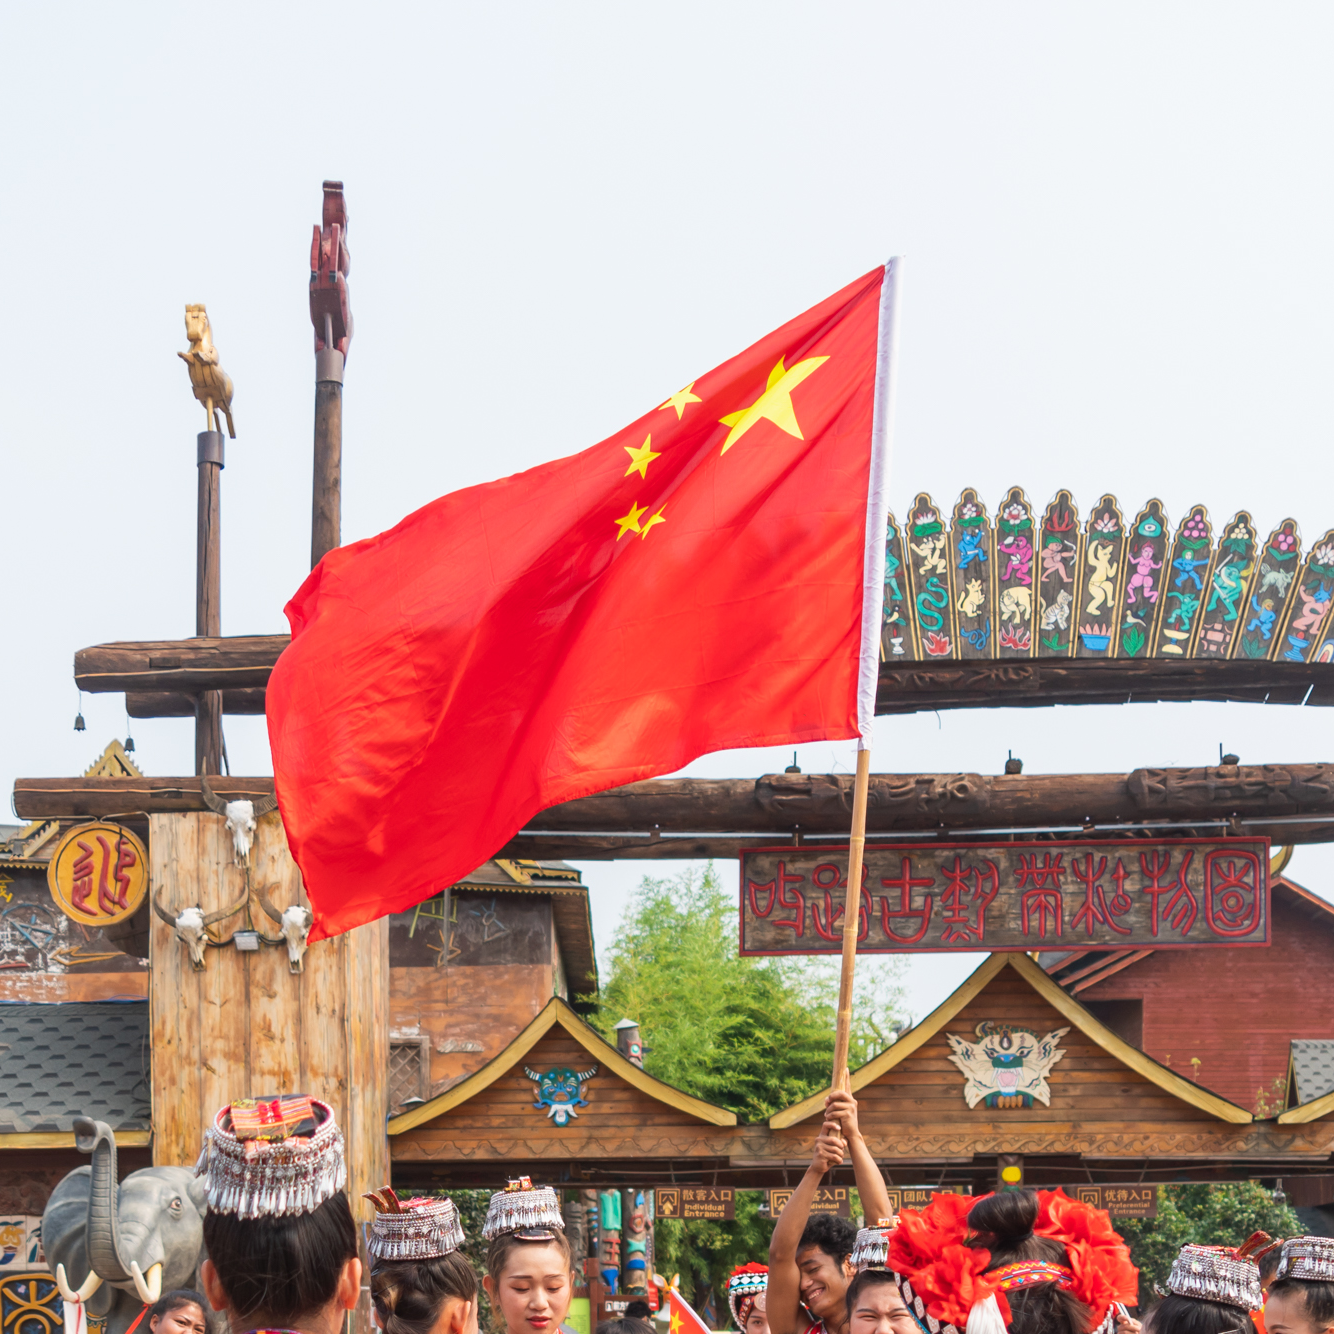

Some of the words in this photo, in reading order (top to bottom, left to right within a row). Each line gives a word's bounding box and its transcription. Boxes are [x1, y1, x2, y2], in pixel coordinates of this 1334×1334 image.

[682, 1189, 732, 1201] 散客入口
[812, 1188, 846, 1201] 客入口
[1104, 1189, 1152, 1201] 优待入口
[684, 1203, 725, 1211] Individual
[684, 1210, 725, 1218] Entrance
